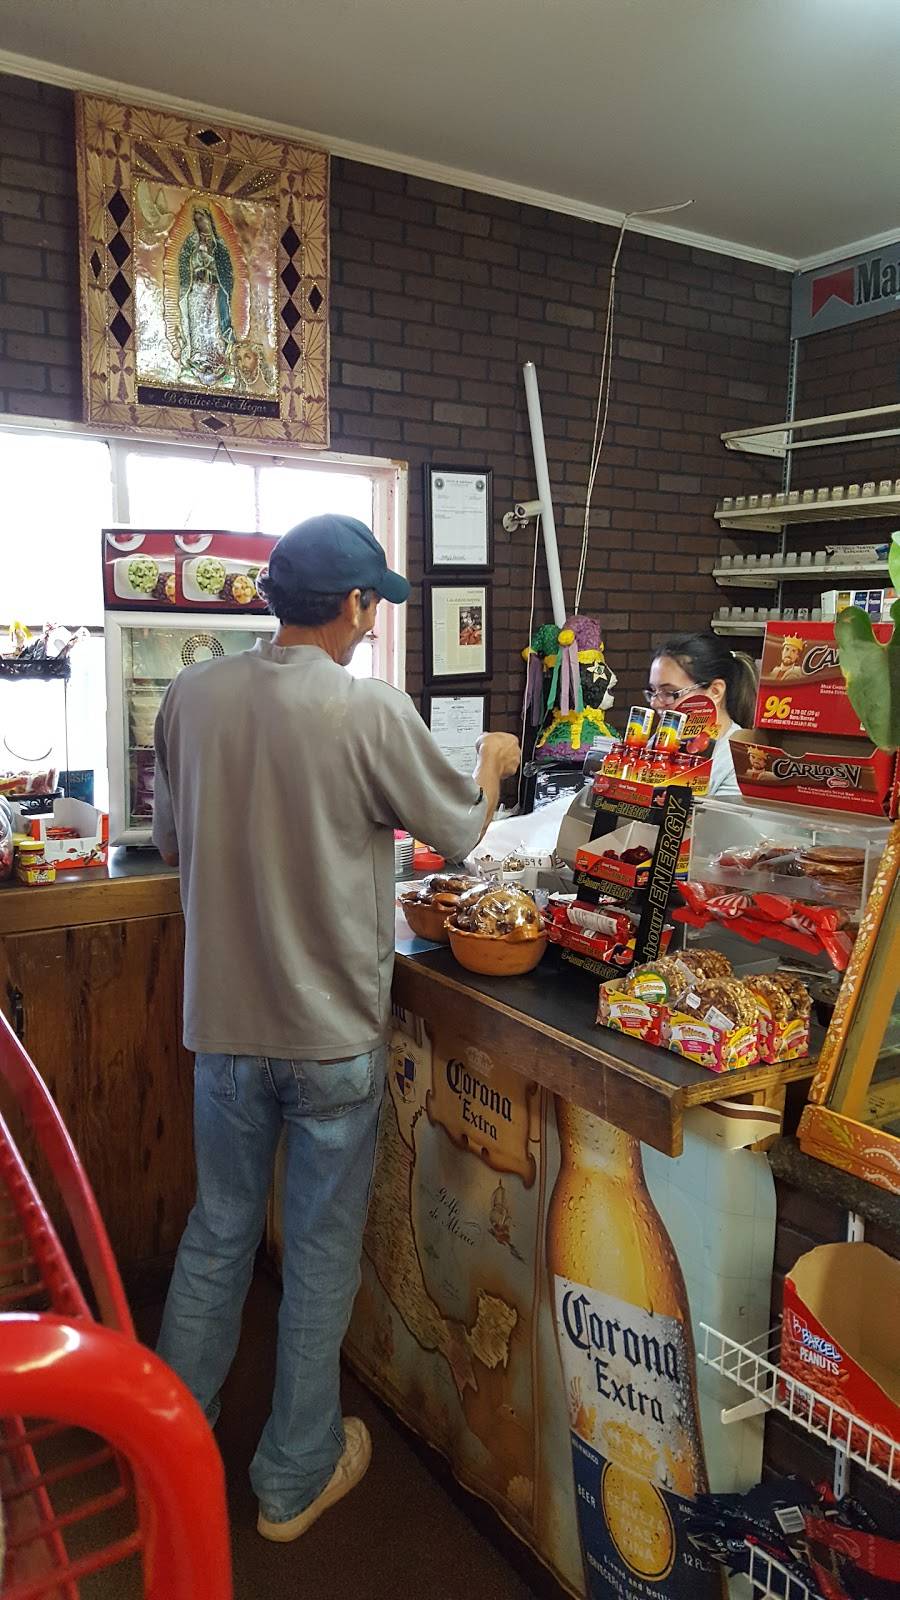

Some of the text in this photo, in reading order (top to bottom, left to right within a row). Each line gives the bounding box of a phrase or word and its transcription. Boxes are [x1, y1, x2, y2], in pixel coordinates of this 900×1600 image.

[763, 695, 792, 719] 96
[616, 801, 651, 820] ENERGY
[649, 795, 687, 909] ENERGY
[600, 879, 634, 900] ENERGY
[447, 1058, 512, 1122] Corona
[462, 1098, 497, 1140] Extra
[562, 1290, 680, 1384] Corona
[800, 1346, 840, 1376] PEANUTS
[594, 1356, 664, 1425] Extra
[577, 1483, 596, 1509] BEER
[628, 1577, 643, 1592] and
